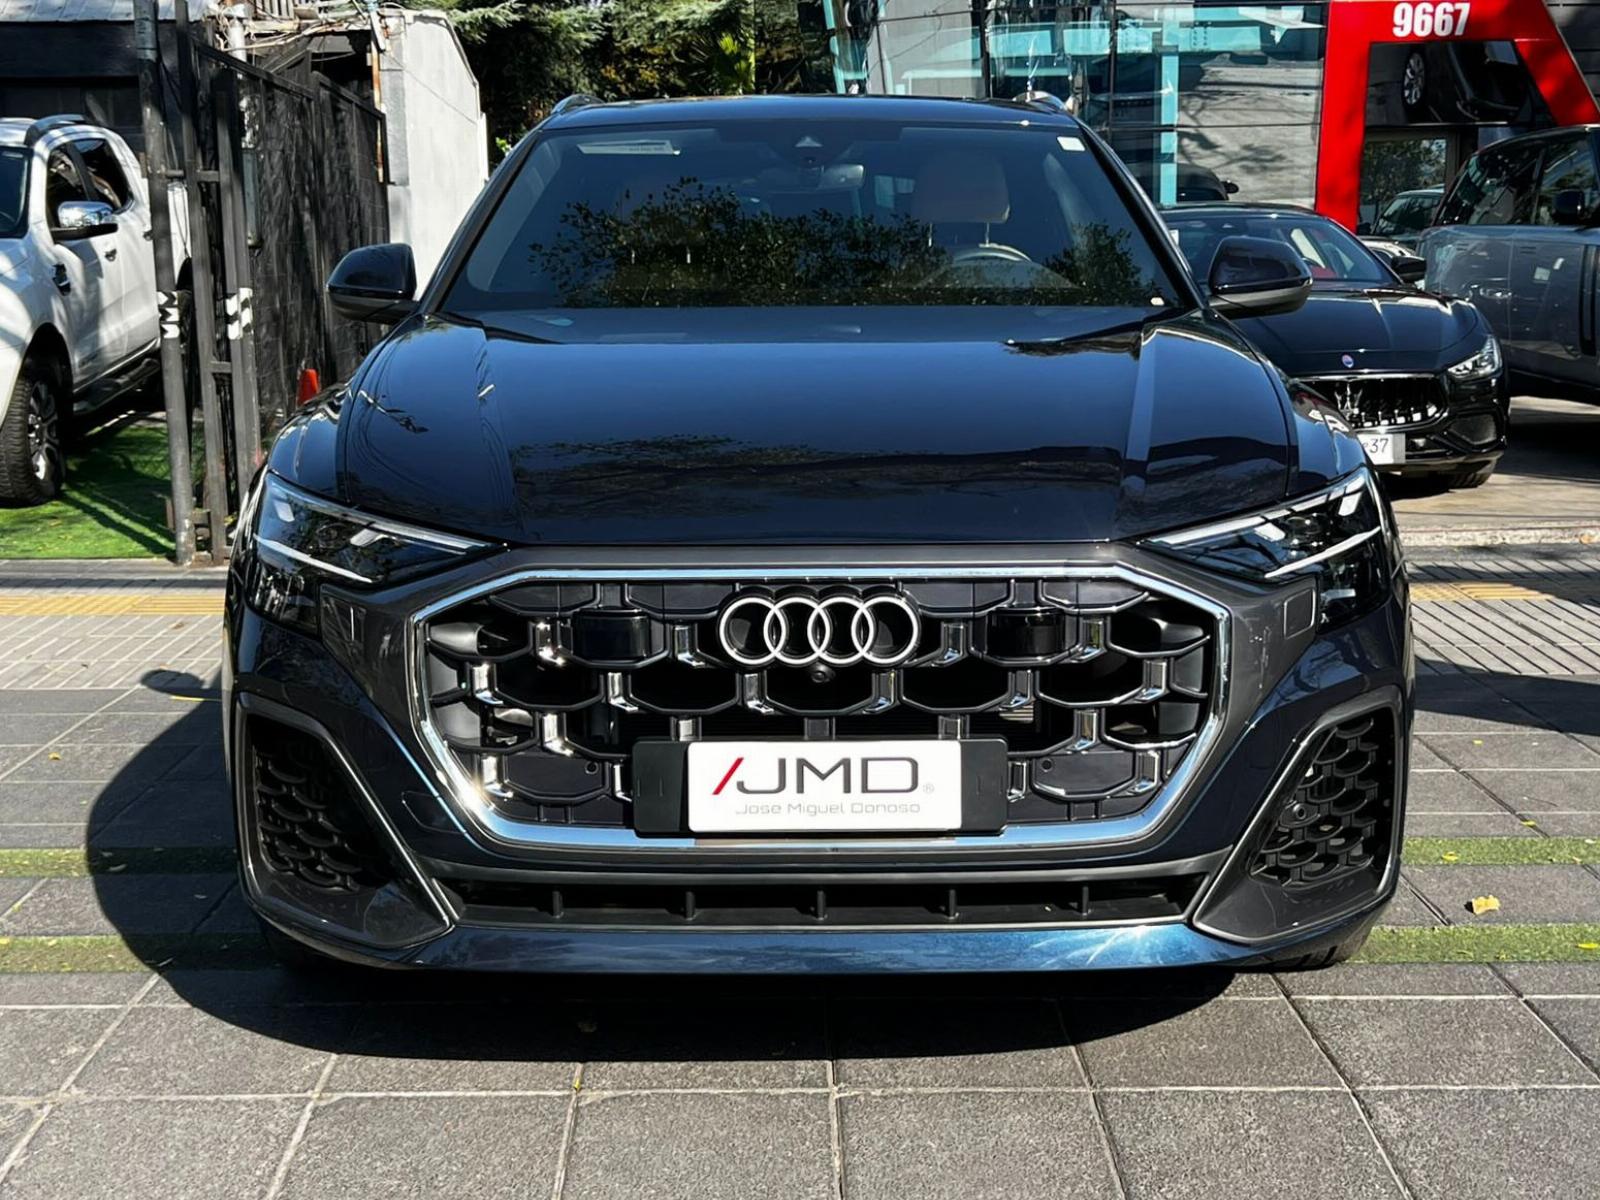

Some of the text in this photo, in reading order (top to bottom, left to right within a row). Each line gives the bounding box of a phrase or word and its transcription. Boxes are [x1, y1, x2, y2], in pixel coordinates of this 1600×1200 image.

[1392, 2, 1471, 37] 9667
[735, 802, 921, 816] Jose Miguel Donoso
